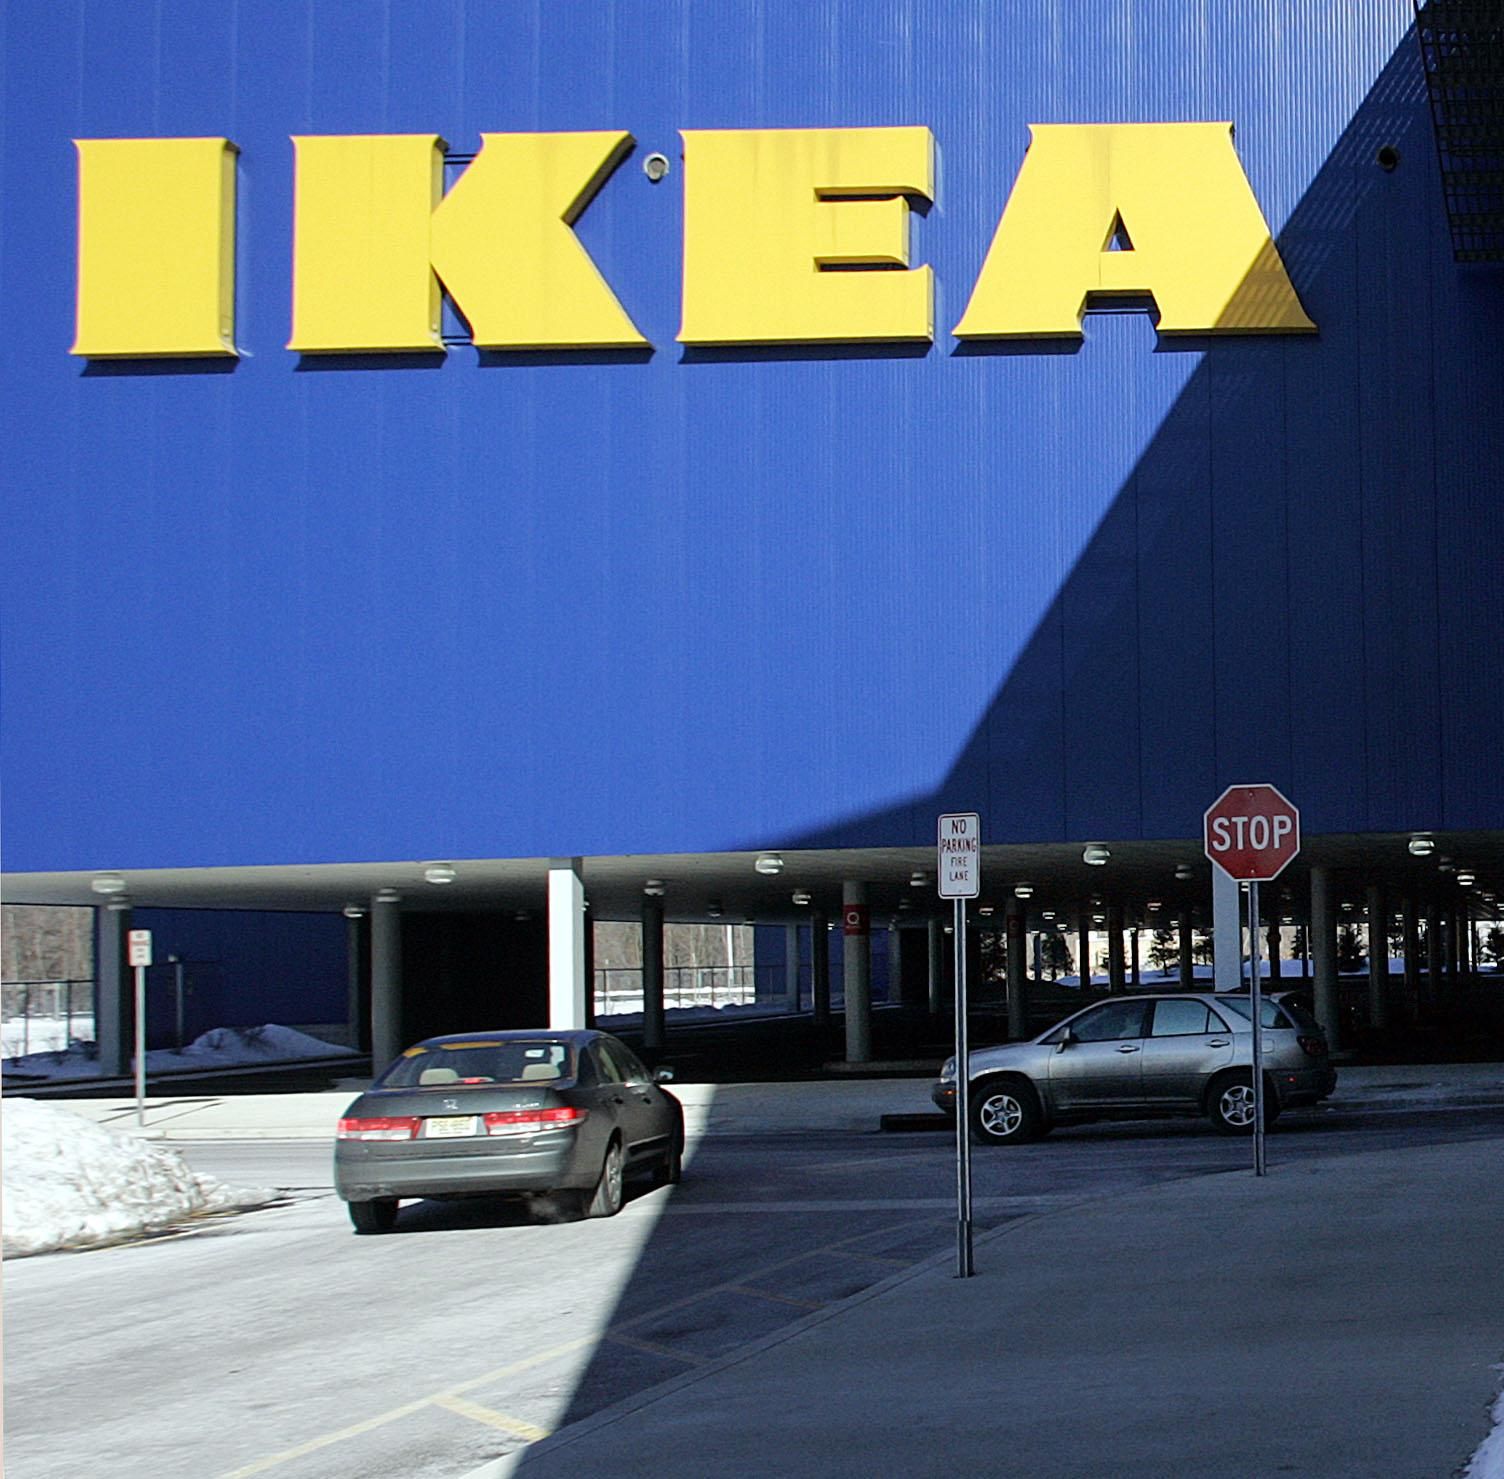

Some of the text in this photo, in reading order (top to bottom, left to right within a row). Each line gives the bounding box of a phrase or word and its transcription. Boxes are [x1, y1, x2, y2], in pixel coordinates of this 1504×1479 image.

[68, 121, 1319, 357] IKEA
[951, 819, 967, 834] NO
[1212, 815, 1292, 851] STOP
[942, 838, 976, 853] PARKING
[951, 856, 967, 867] FIRE
[949, 871, 968, 881] LANE
